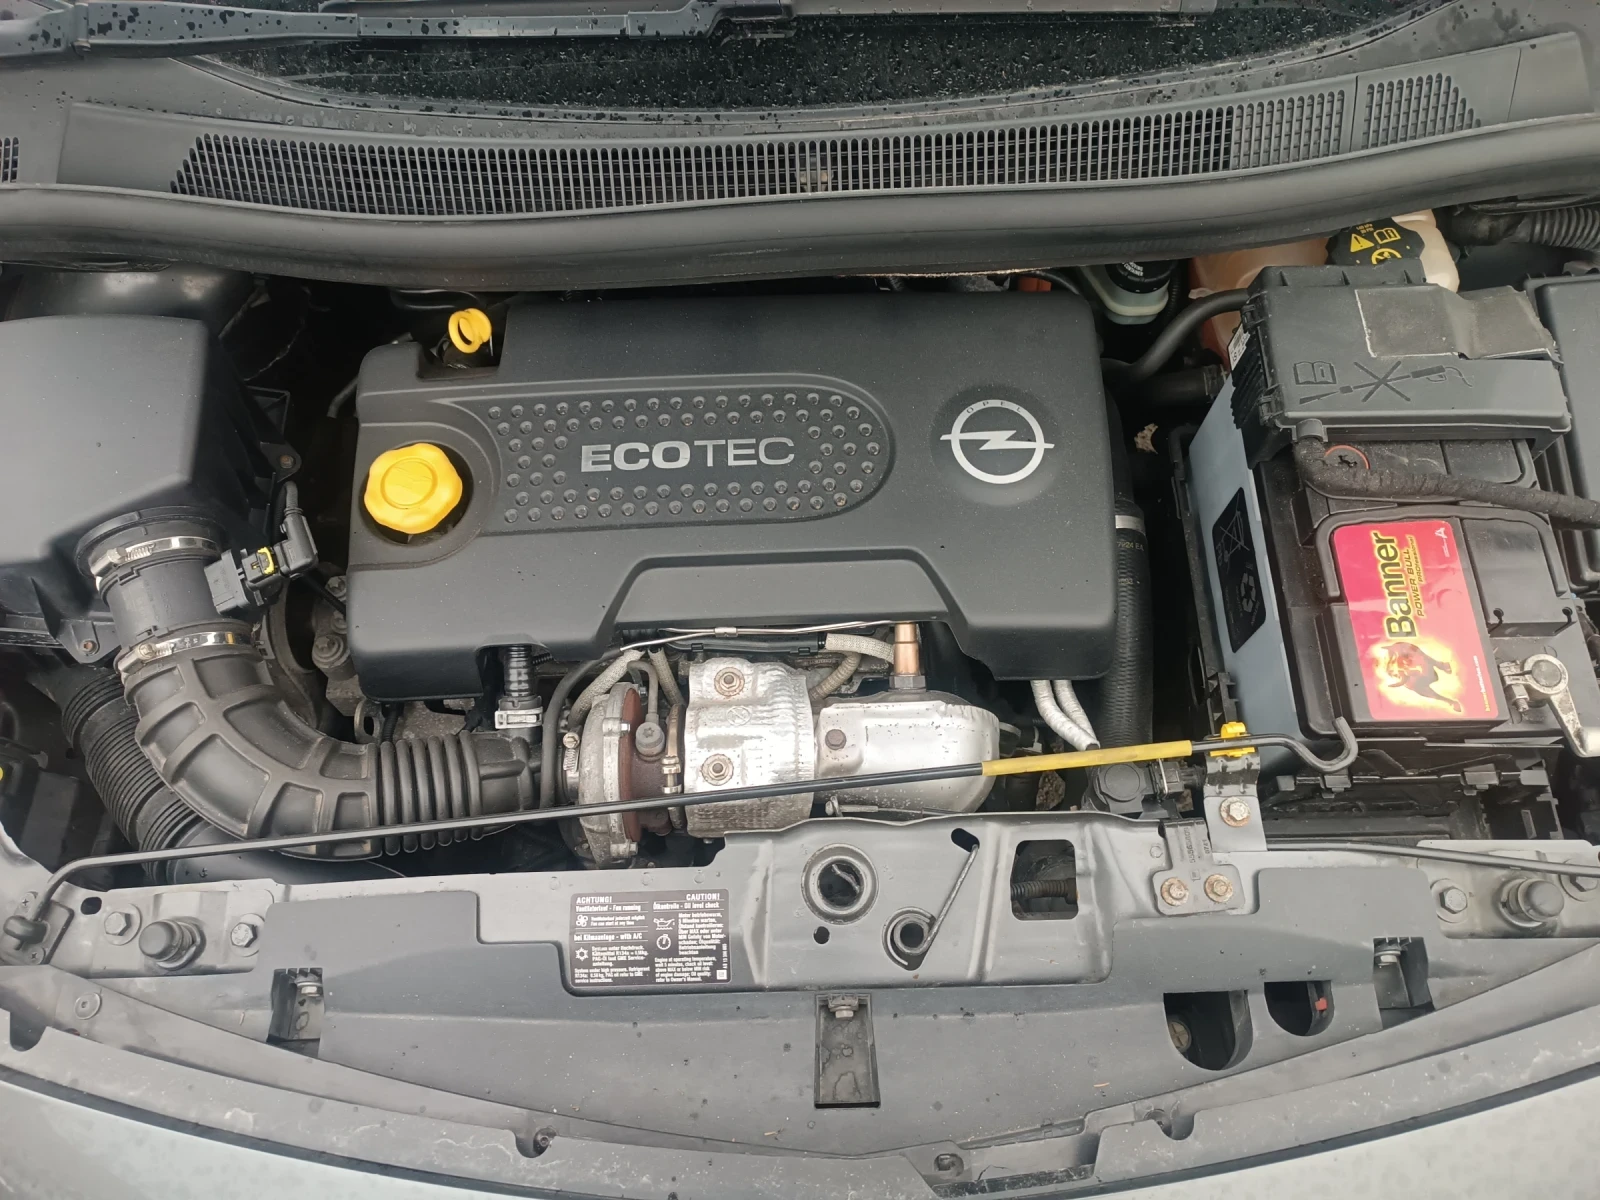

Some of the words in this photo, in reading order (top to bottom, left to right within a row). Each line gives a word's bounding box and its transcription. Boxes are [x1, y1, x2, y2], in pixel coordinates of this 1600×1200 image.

[966, 401, 1021, 414] OPEL
[581, 437, 795, 473] ECOTEC
[1403, 548, 1414, 575] BULL
[1373, 532, 1416, 637] Banner
[1408, 576, 1425, 617] POWER
[576, 896, 612, 904] ACHTUNG!
